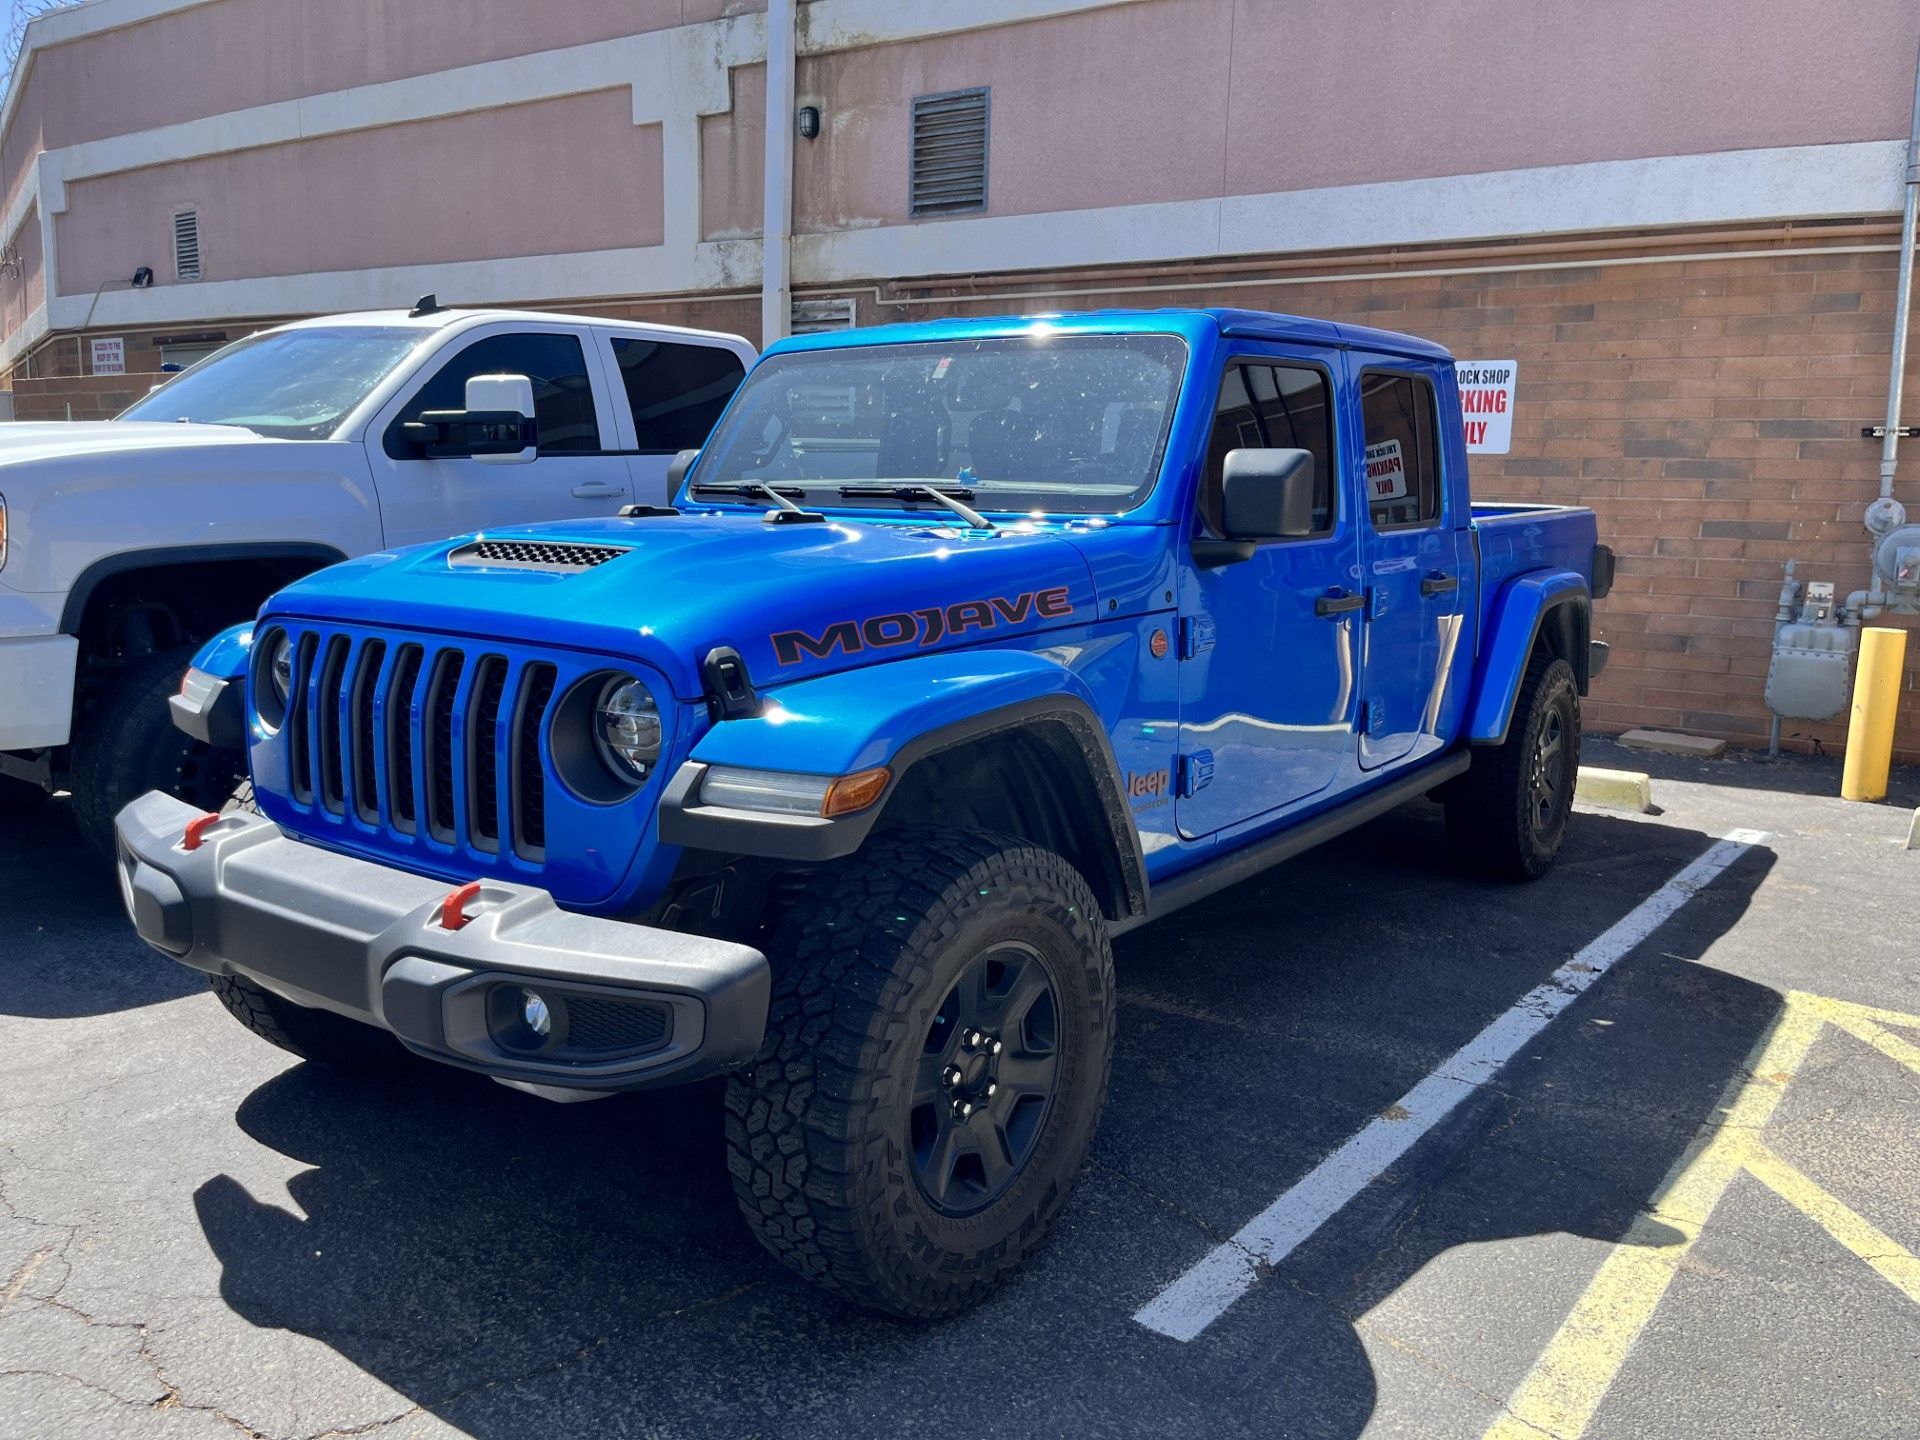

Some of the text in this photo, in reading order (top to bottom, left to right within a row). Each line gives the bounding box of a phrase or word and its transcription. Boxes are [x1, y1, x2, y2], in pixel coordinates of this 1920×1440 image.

[1459, 369, 1510, 384] OCK SHOP
[1459, 389, 1507, 413] KING
[1464, 421, 1487, 445] LY
[770, 586, 1073, 667] MOJAVE
[1128, 768, 1169, 797] Jeep
